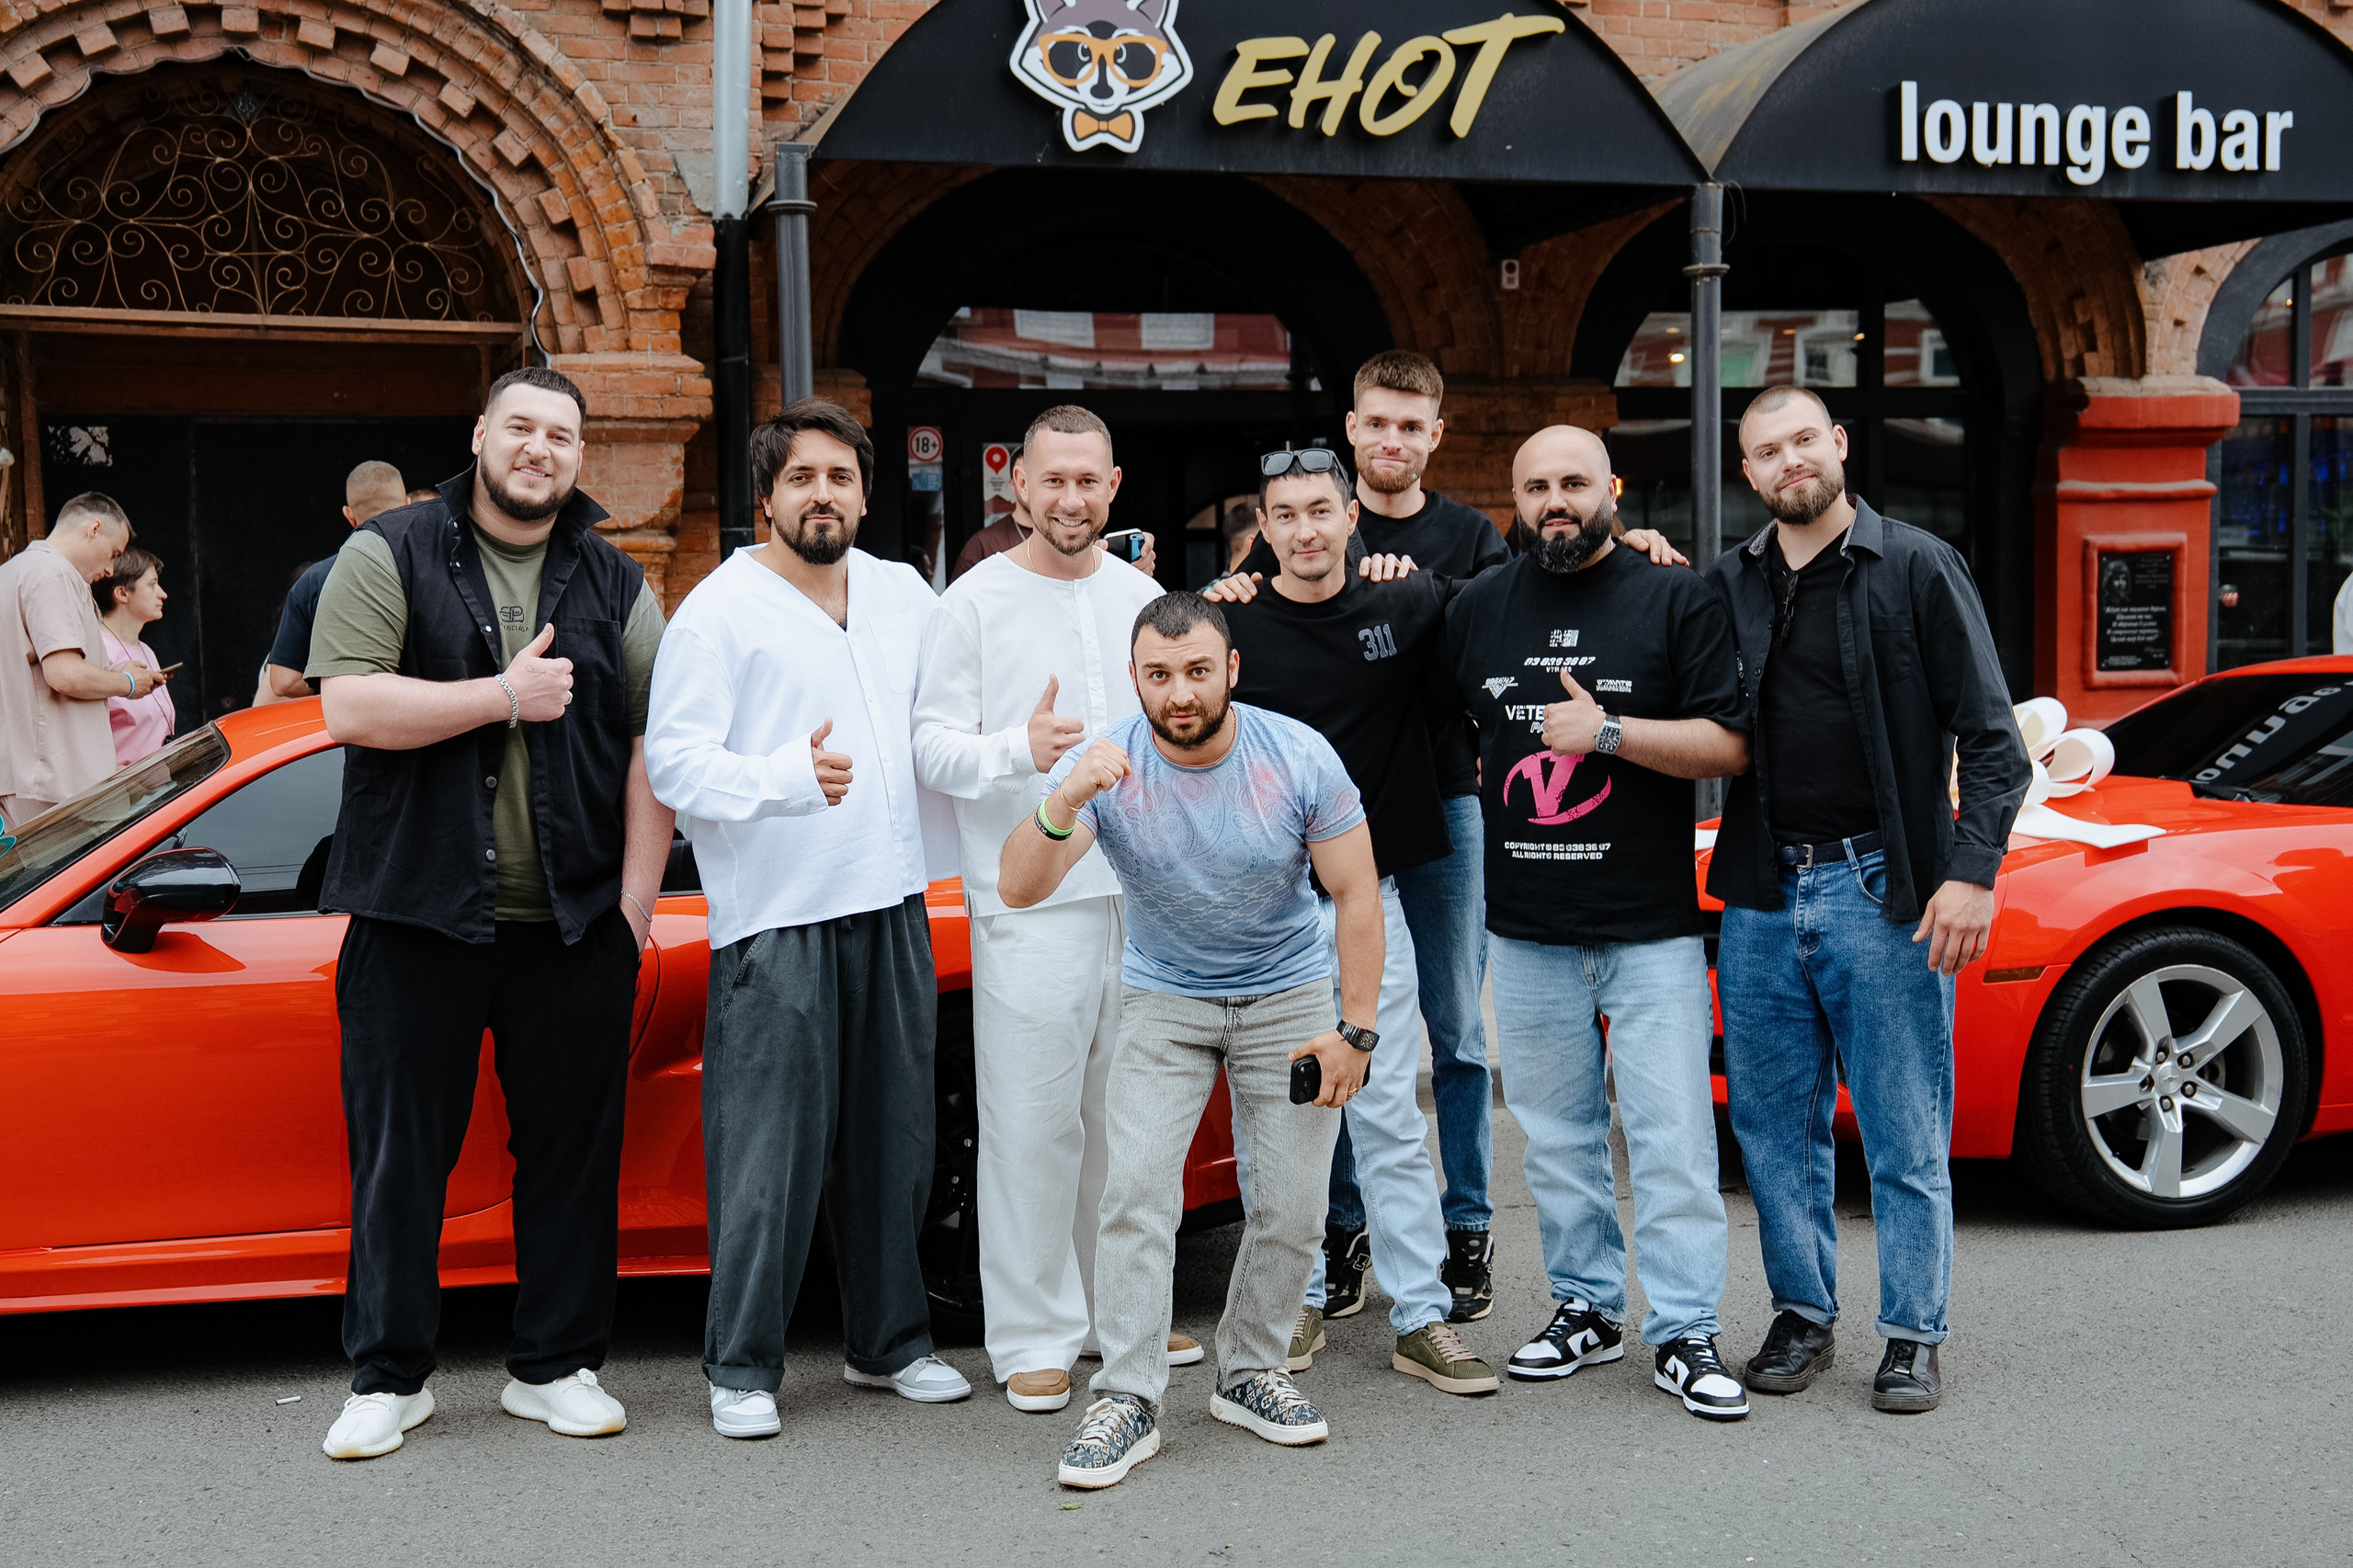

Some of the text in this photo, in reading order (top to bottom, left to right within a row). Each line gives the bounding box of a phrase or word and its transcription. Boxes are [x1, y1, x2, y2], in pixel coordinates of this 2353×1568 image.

[1900, 80, 2294, 187] lounge bar
[915, 436, 938, 454] 18+
[1358, 623, 1398, 662] 311
[1504, 841, 1545, 850] COPYRIGHT
[1512, 850, 1603, 860] ALL RIGHTS RESERVED
